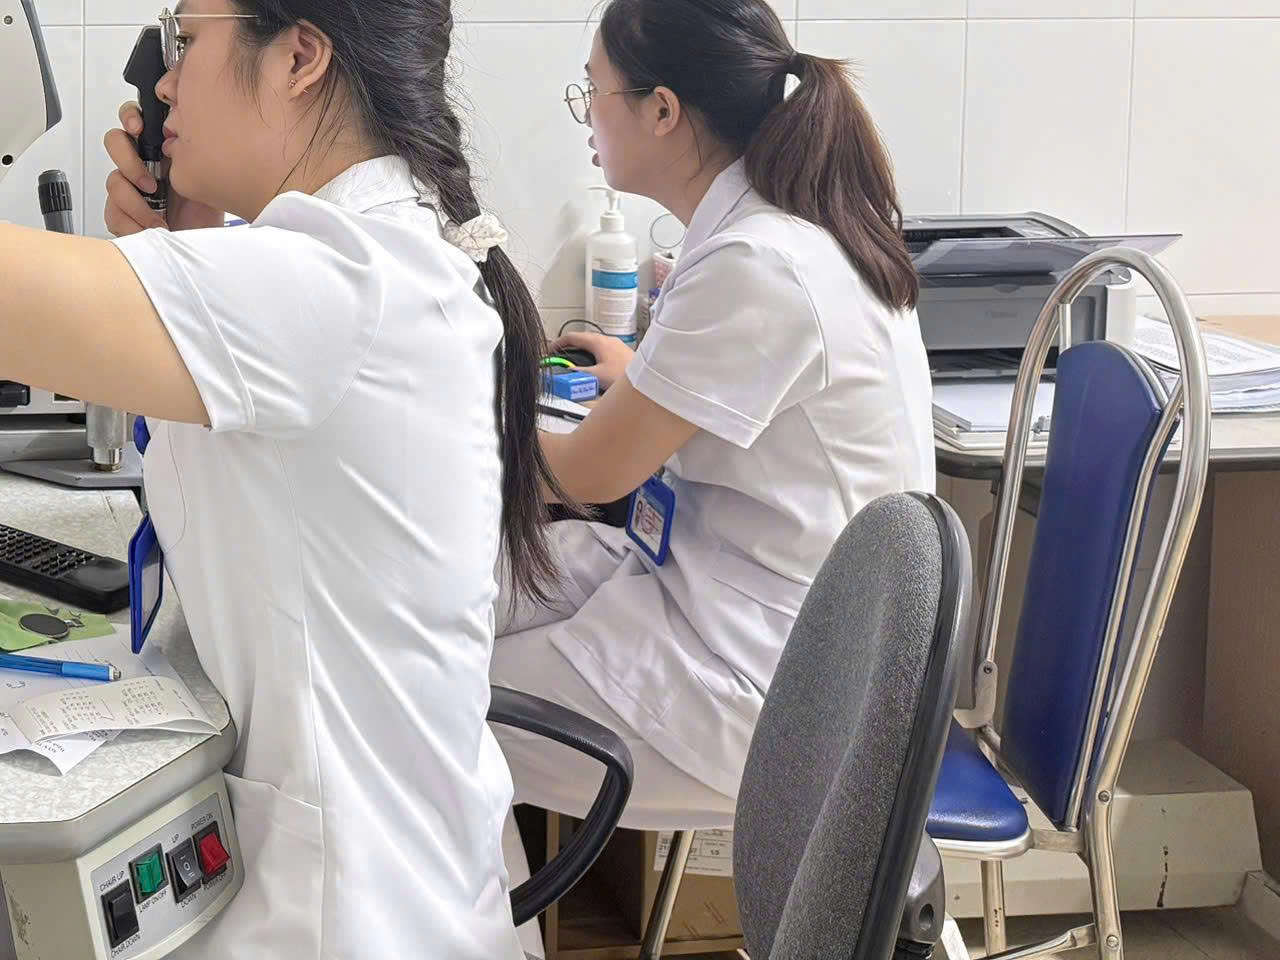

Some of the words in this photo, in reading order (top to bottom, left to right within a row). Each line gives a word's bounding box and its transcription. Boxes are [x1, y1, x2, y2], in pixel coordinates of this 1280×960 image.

[171, 834, 179, 843] UP
[100, 877, 116, 892] CHAIR
[117, 870, 124, 880] UP
[140, 899, 151, 913] LAMP
[181, 893, 197, 908] DOWN
[111, 946, 125, 958] CHAIR
[125, 934, 141, 948] DOWN
